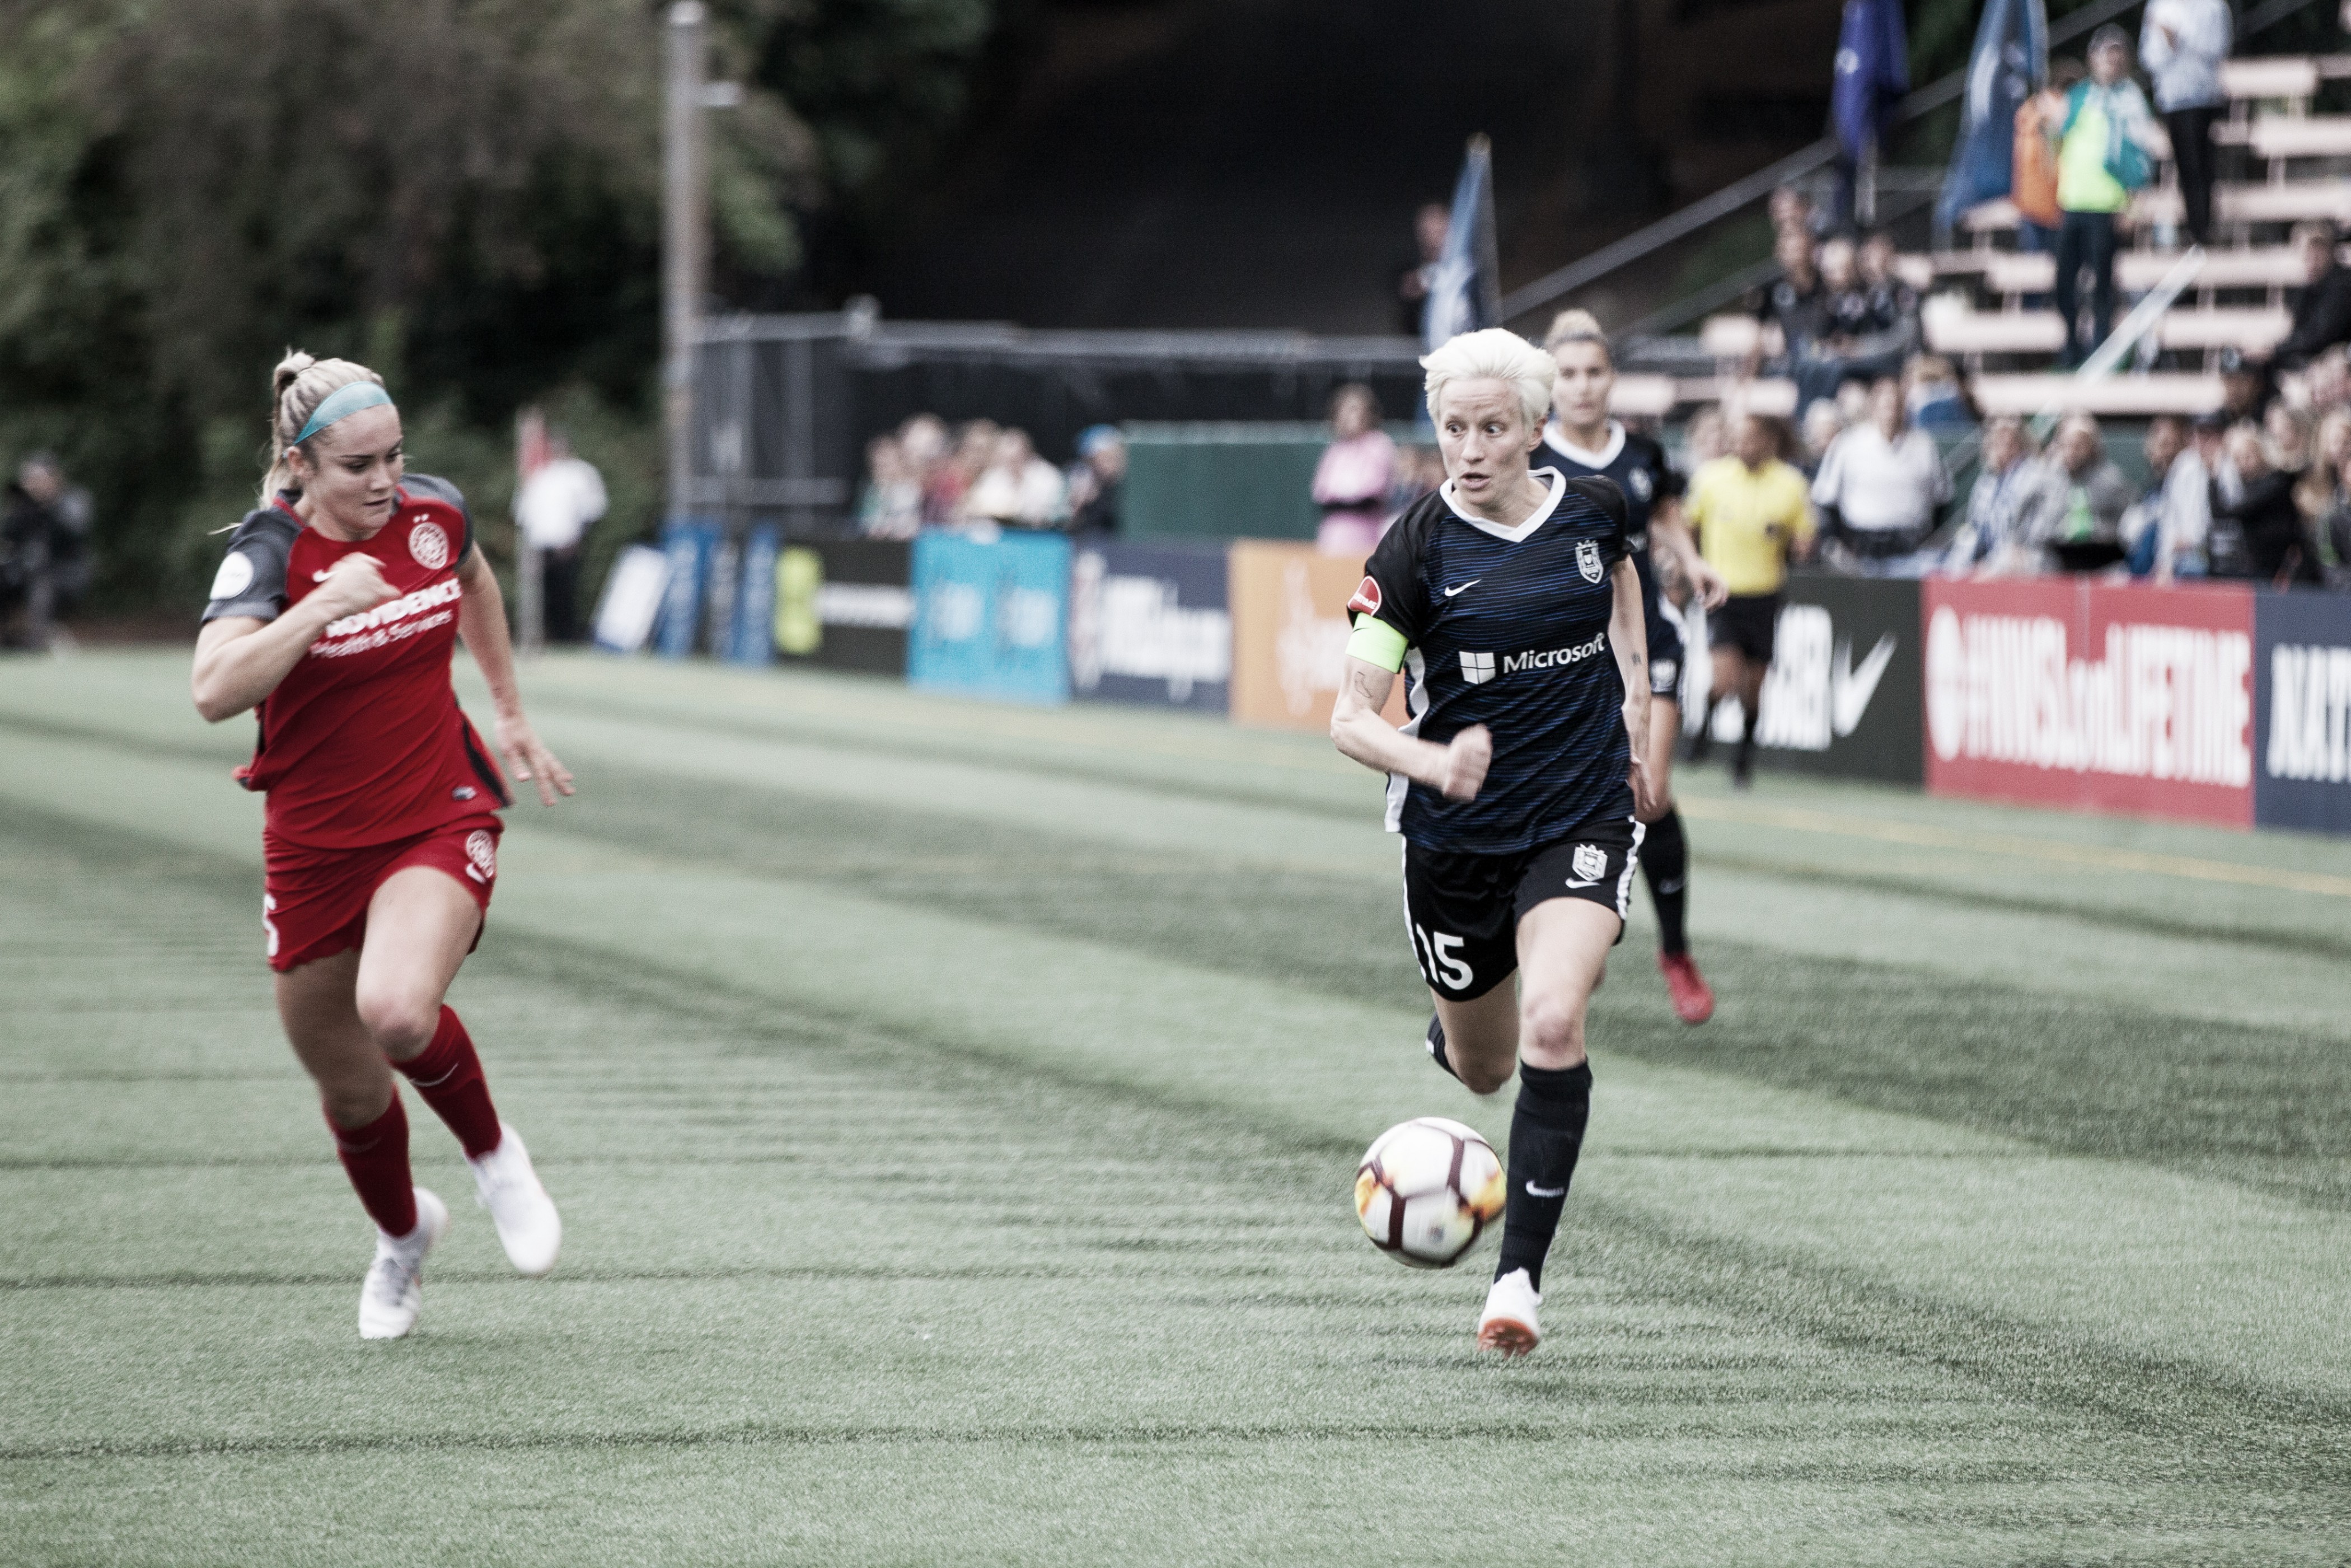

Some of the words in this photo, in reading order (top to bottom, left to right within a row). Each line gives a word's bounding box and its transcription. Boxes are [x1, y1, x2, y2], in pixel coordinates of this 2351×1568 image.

[325, 577, 463, 638] ROVIDENCE
[1504, 632, 1605, 673] Microsoft
[1416, 923, 1474, 990] 15
